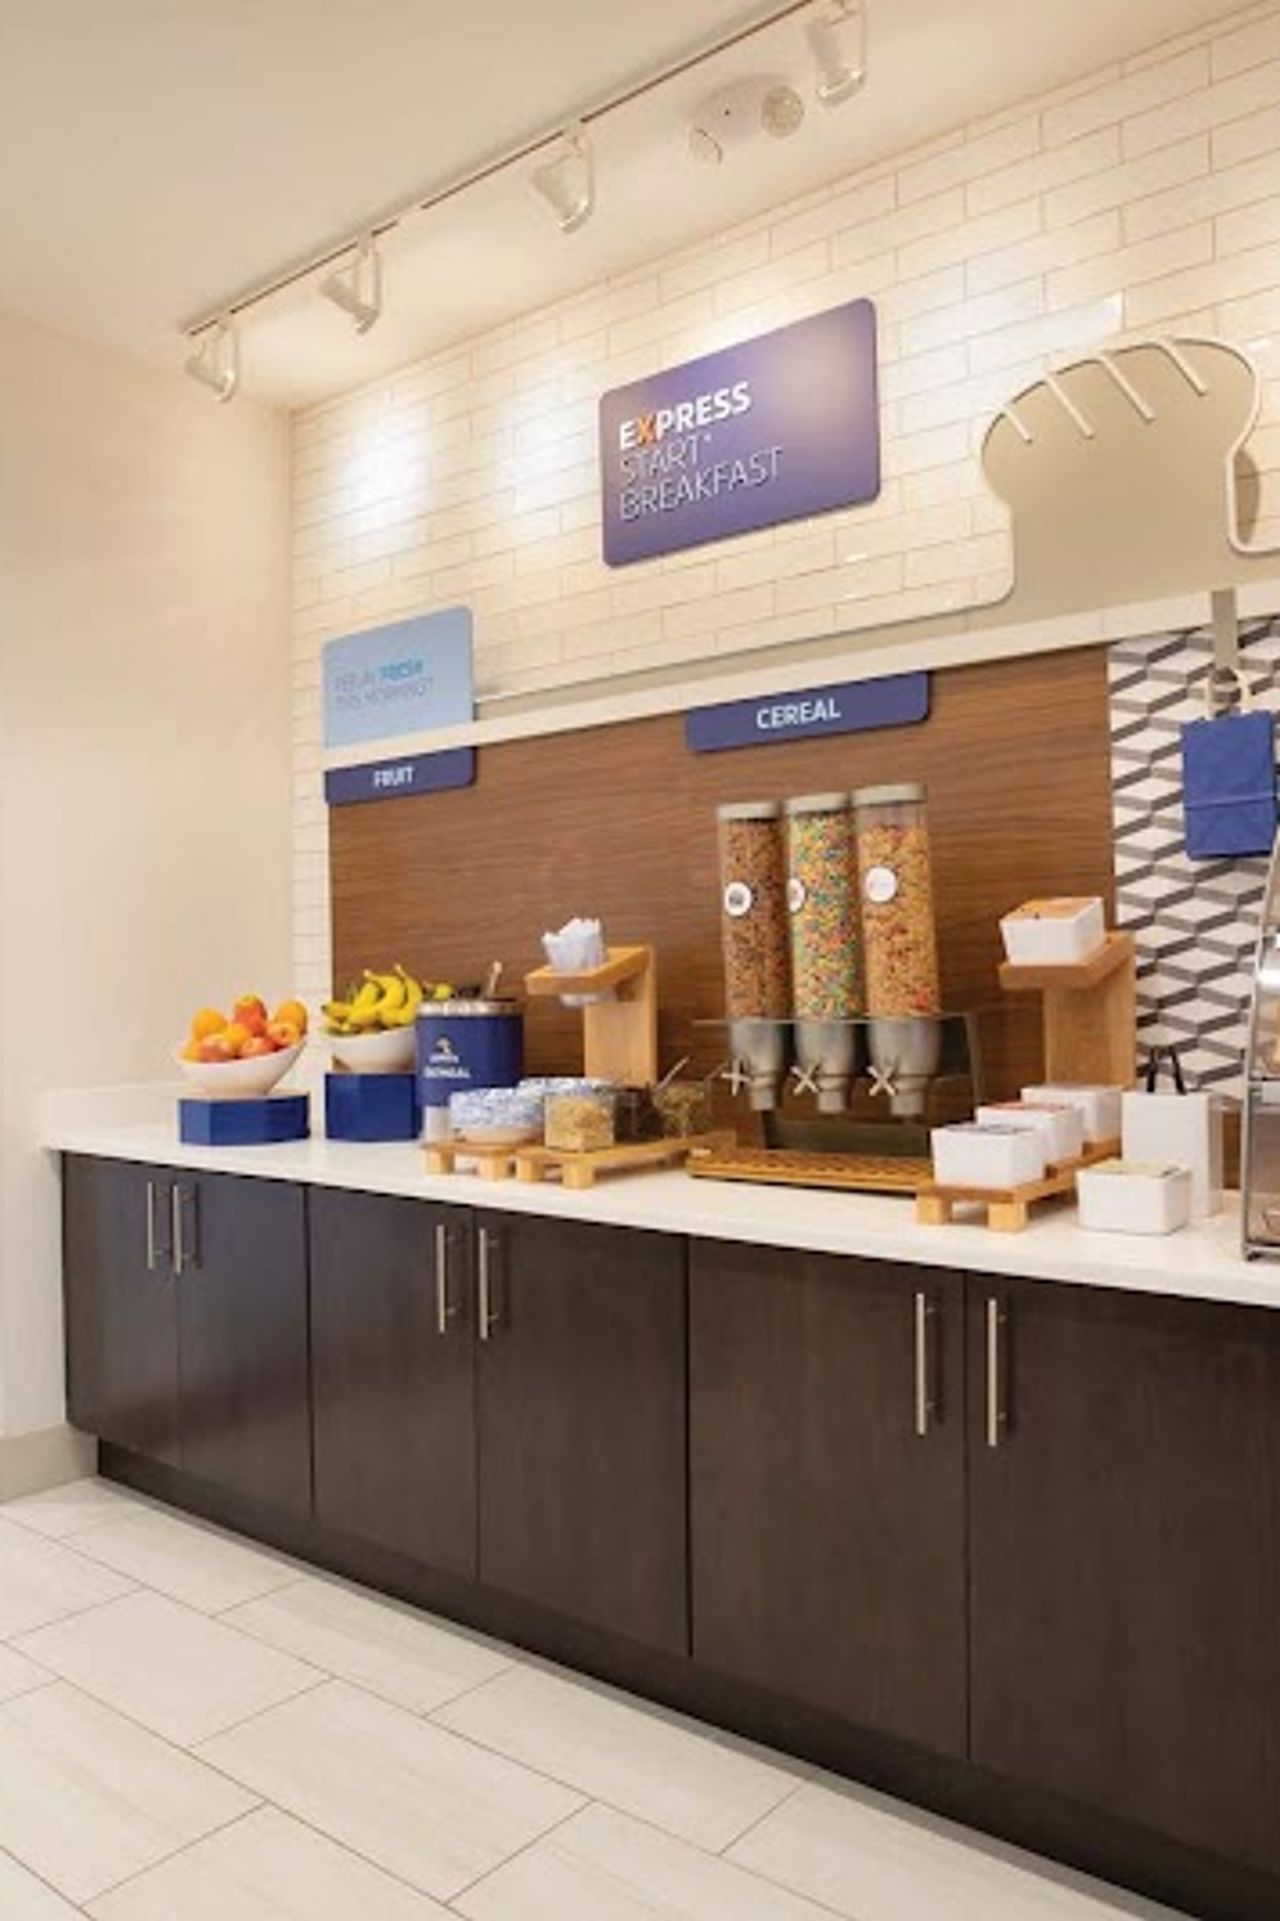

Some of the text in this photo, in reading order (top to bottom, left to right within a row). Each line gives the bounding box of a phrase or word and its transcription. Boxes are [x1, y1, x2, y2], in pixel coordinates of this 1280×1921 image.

[619, 381, 751, 450] EXPRESS
[619, 446, 783, 521] BREAKFAST
[756, 698, 841, 729] CEREAL
[373, 766, 414, 787] FRUIT
